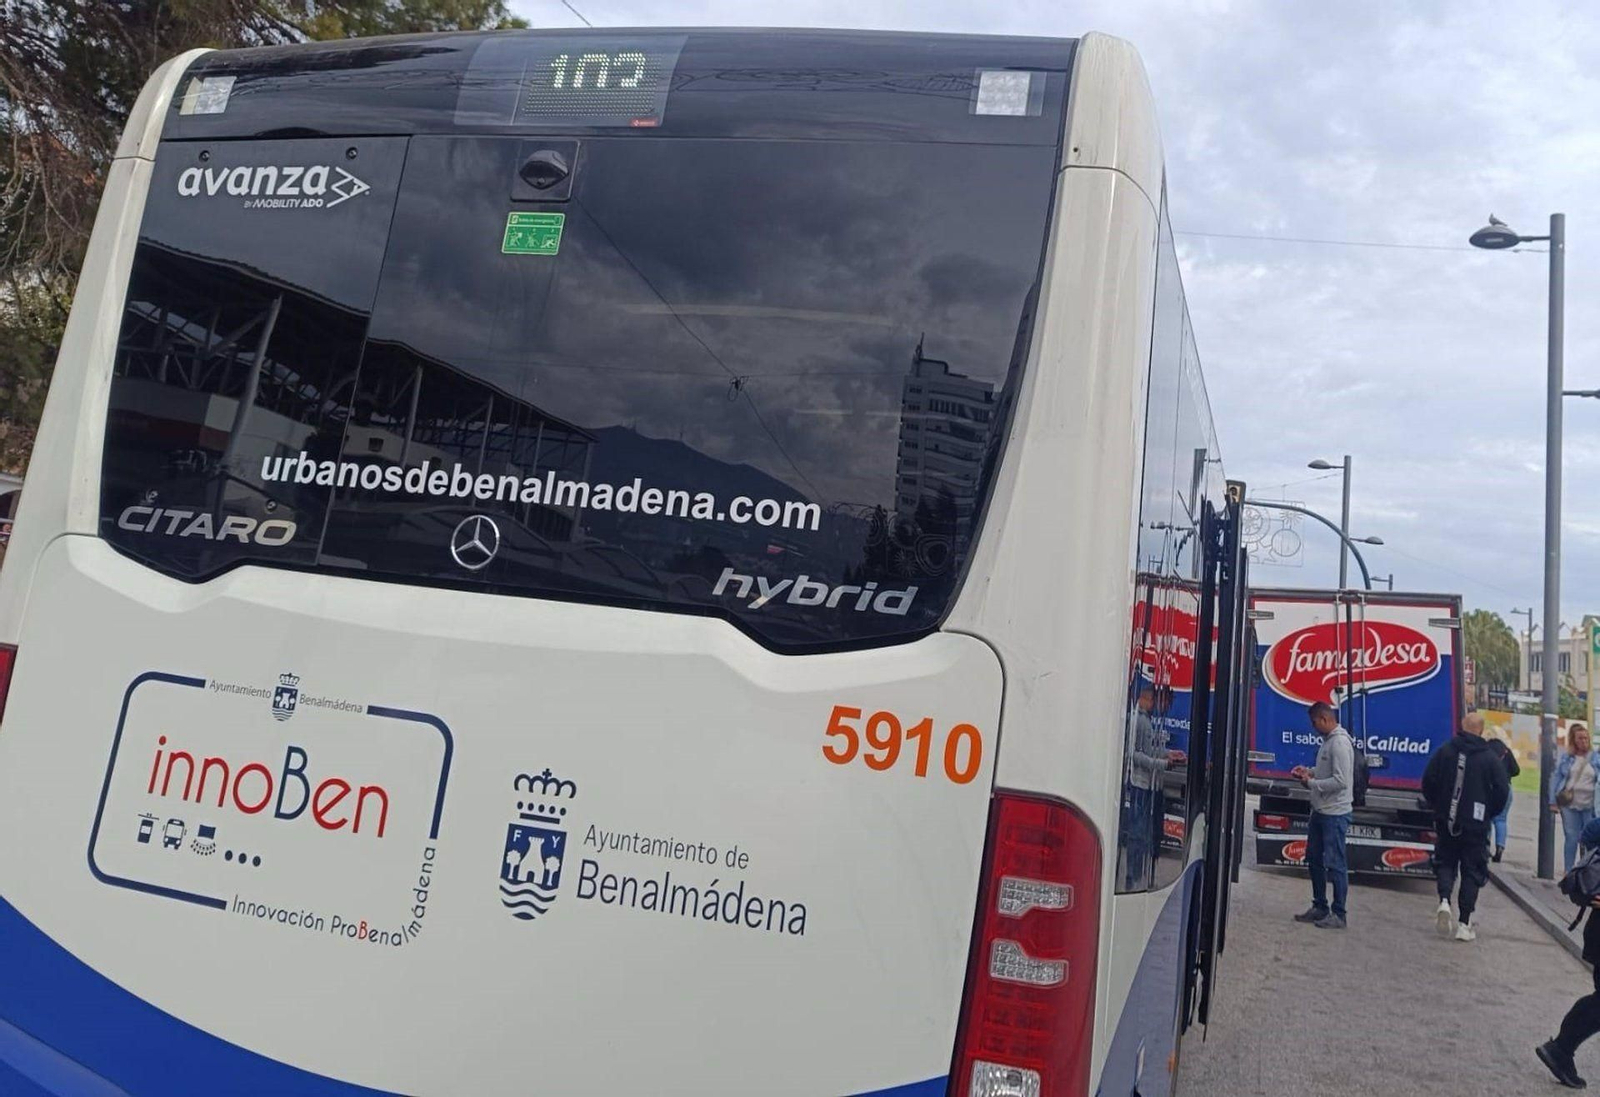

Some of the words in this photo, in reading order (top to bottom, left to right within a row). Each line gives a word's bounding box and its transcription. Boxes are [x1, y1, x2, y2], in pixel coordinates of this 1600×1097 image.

[178, 165, 330, 197] avanza
[252, 199, 301, 209] MOBILITY
[301, 198, 324, 209] ADO
[260, 451, 821, 532] urbanosdebenalmadena.com
[117, 505, 297, 547] CITARO
[712, 567, 919, 616] hybrid
[209, 680, 272, 699] Ayuntamiento
[299, 693, 364, 714] Benalmádena
[822, 705, 983, 785] 5910
[1282, 731, 1293, 743] El
[1295, 733, 1324, 746] sabo
[1367, 735, 1430, 754] Calidad
[147, 735, 389, 838] innoBen
[583, 824, 718, 865] Ayuntamiento
[725, 845, 750, 870] de
[231, 894, 324, 932] Innovación
[576, 858, 807, 936] Benalmádena
